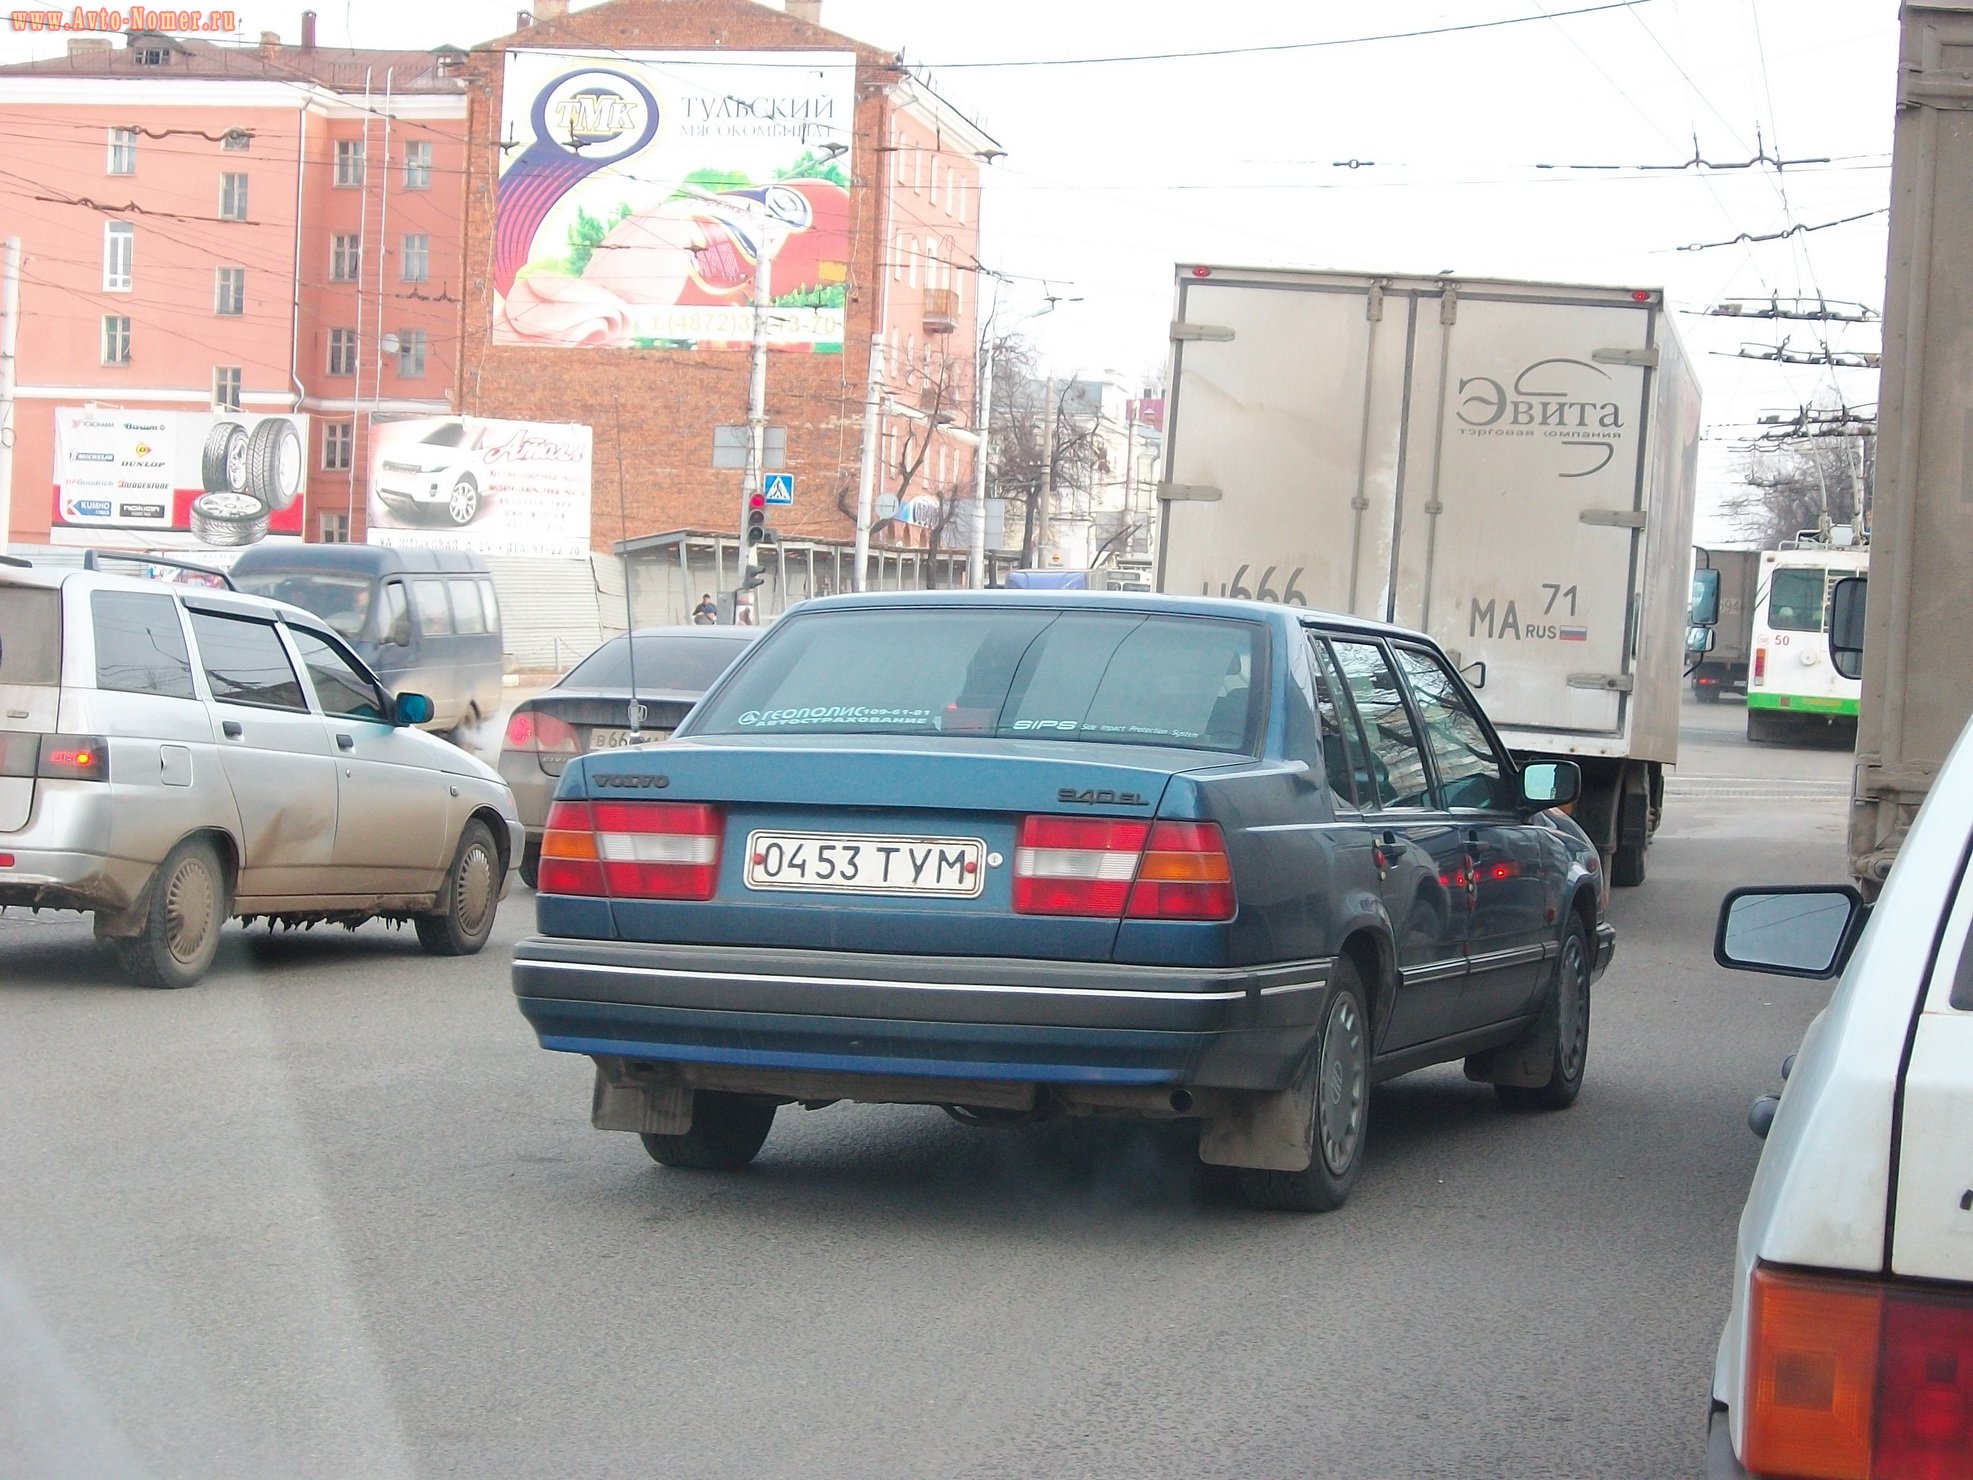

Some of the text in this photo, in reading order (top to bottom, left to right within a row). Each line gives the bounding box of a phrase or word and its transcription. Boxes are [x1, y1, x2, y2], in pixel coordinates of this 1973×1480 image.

[556, 95, 638, 132] ТМК
[681, 94, 834, 121] ТУЛЬСКИЙ
[1456, 377, 1624, 429] Эвита
[81, 501, 110, 510] KUMHO
[1469, 597, 1521, 640] МА
[1542, 583, 1577, 616] 71
[1525, 624, 1557, 639] RUS
[1775, 634, 1790, 646] 50
[755, 717, 927, 727] АВТОСТРАХОВАНИЕ
[760, 706, 866, 721] ГЕОПОЛИС
[1012, 720, 1078, 731] SIPS
[1101, 724, 1126, 733] Impact
[1129, 725, 1168, 735] Protection
[1171, 729, 1199, 739] System
[592, 774, 670, 788] VOLVO
[763, 842, 966, 885] 0453 ТУМ
